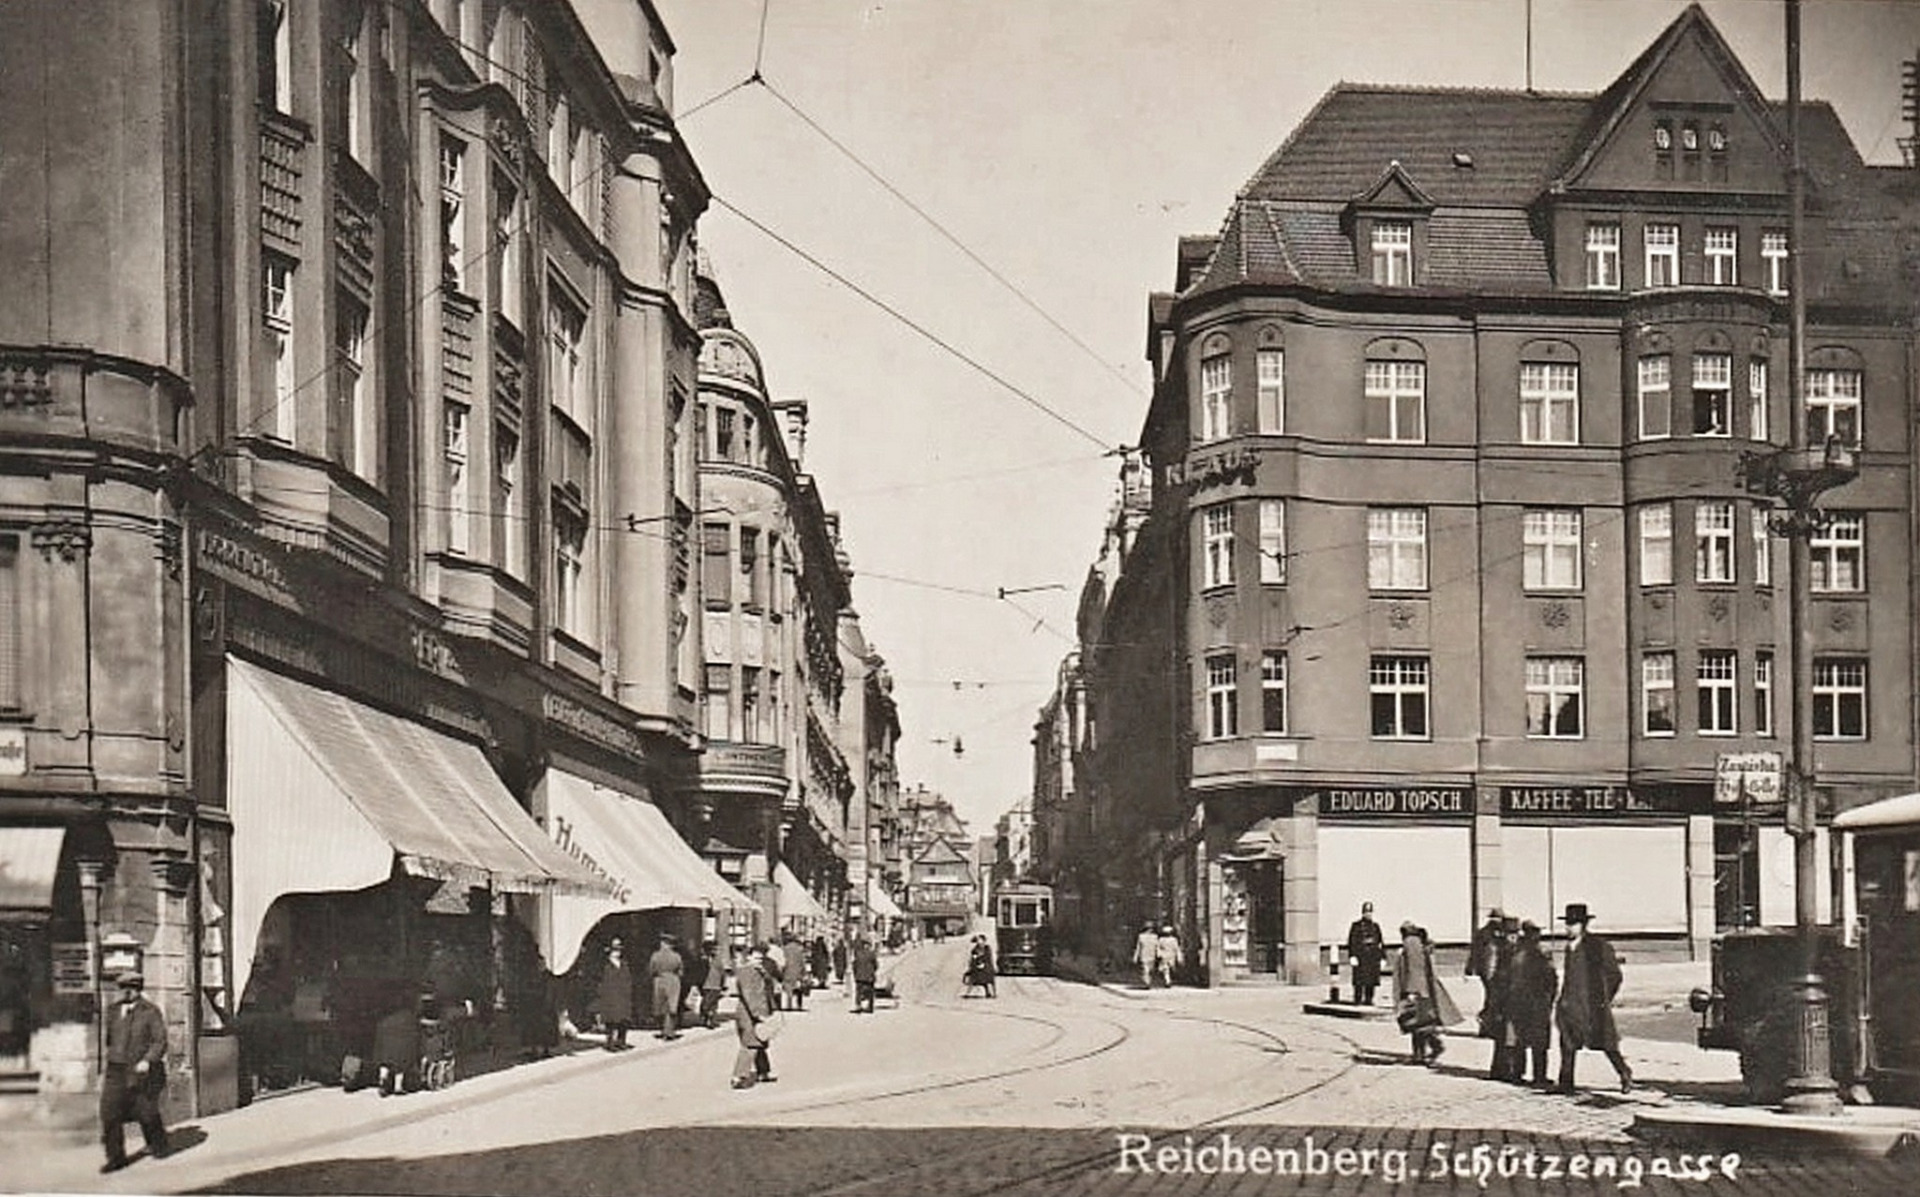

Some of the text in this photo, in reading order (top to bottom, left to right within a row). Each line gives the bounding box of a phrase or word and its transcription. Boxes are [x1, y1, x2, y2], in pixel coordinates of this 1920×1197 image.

[1330, 790, 1462, 811] EDUARD TOPSCH
[1510, 789, 1572, 810] KAFFEE
[1584, 789, 1615, 810] TEE
[555, 816, 632, 904] Humanic
